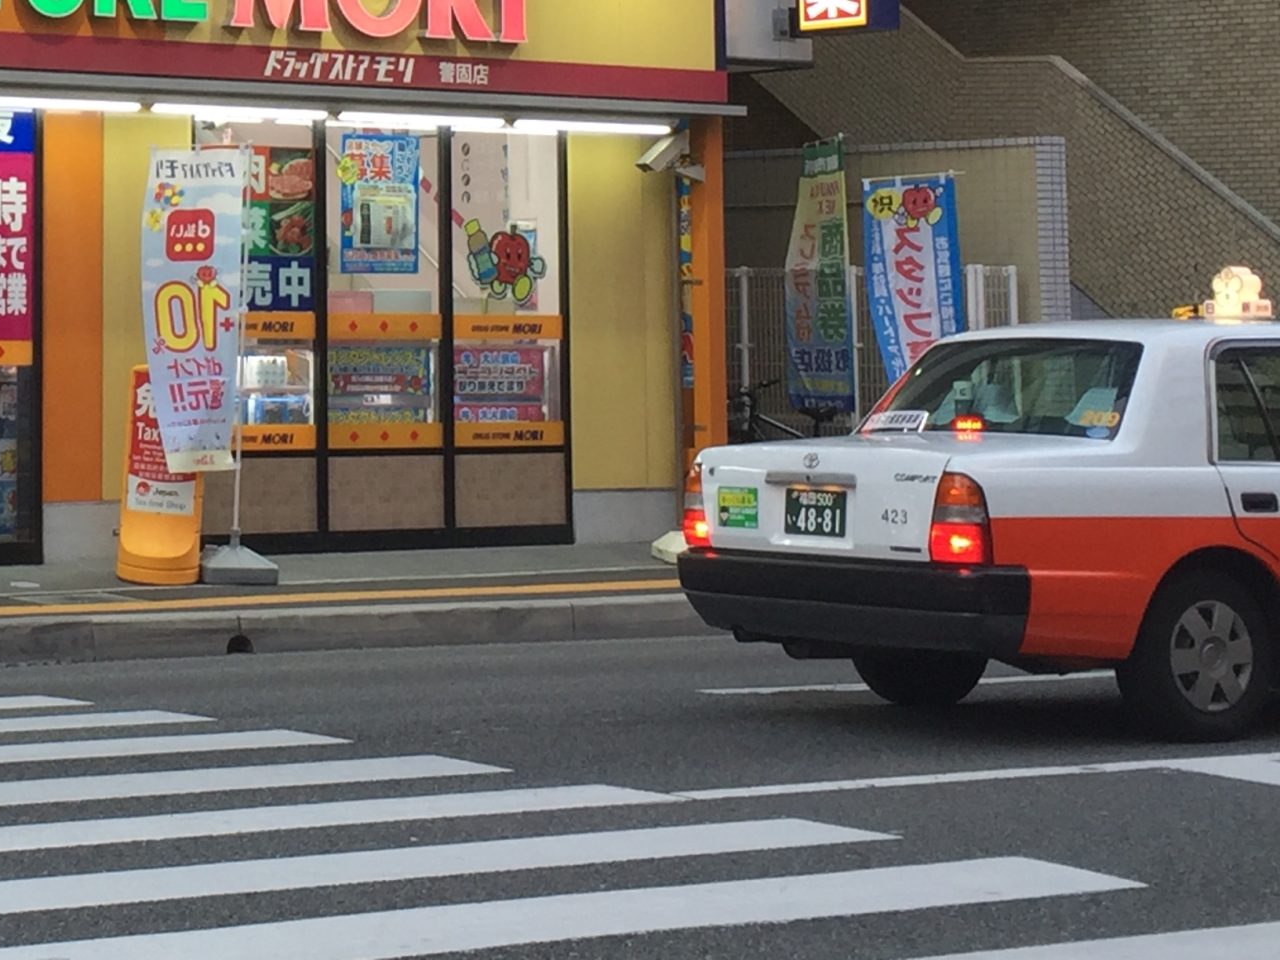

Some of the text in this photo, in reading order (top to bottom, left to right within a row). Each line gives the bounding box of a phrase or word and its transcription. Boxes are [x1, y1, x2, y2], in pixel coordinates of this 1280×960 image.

[439, 61, 489, 85] 警固店
[261, 321, 295, 332] MORI
[512, 324, 543, 334] MORI
[136, 422, 160, 440] Tax
[513, 430, 544, 441] MORI
[260, 432, 294, 444] MORI
[881, 509, 908, 524] 423
